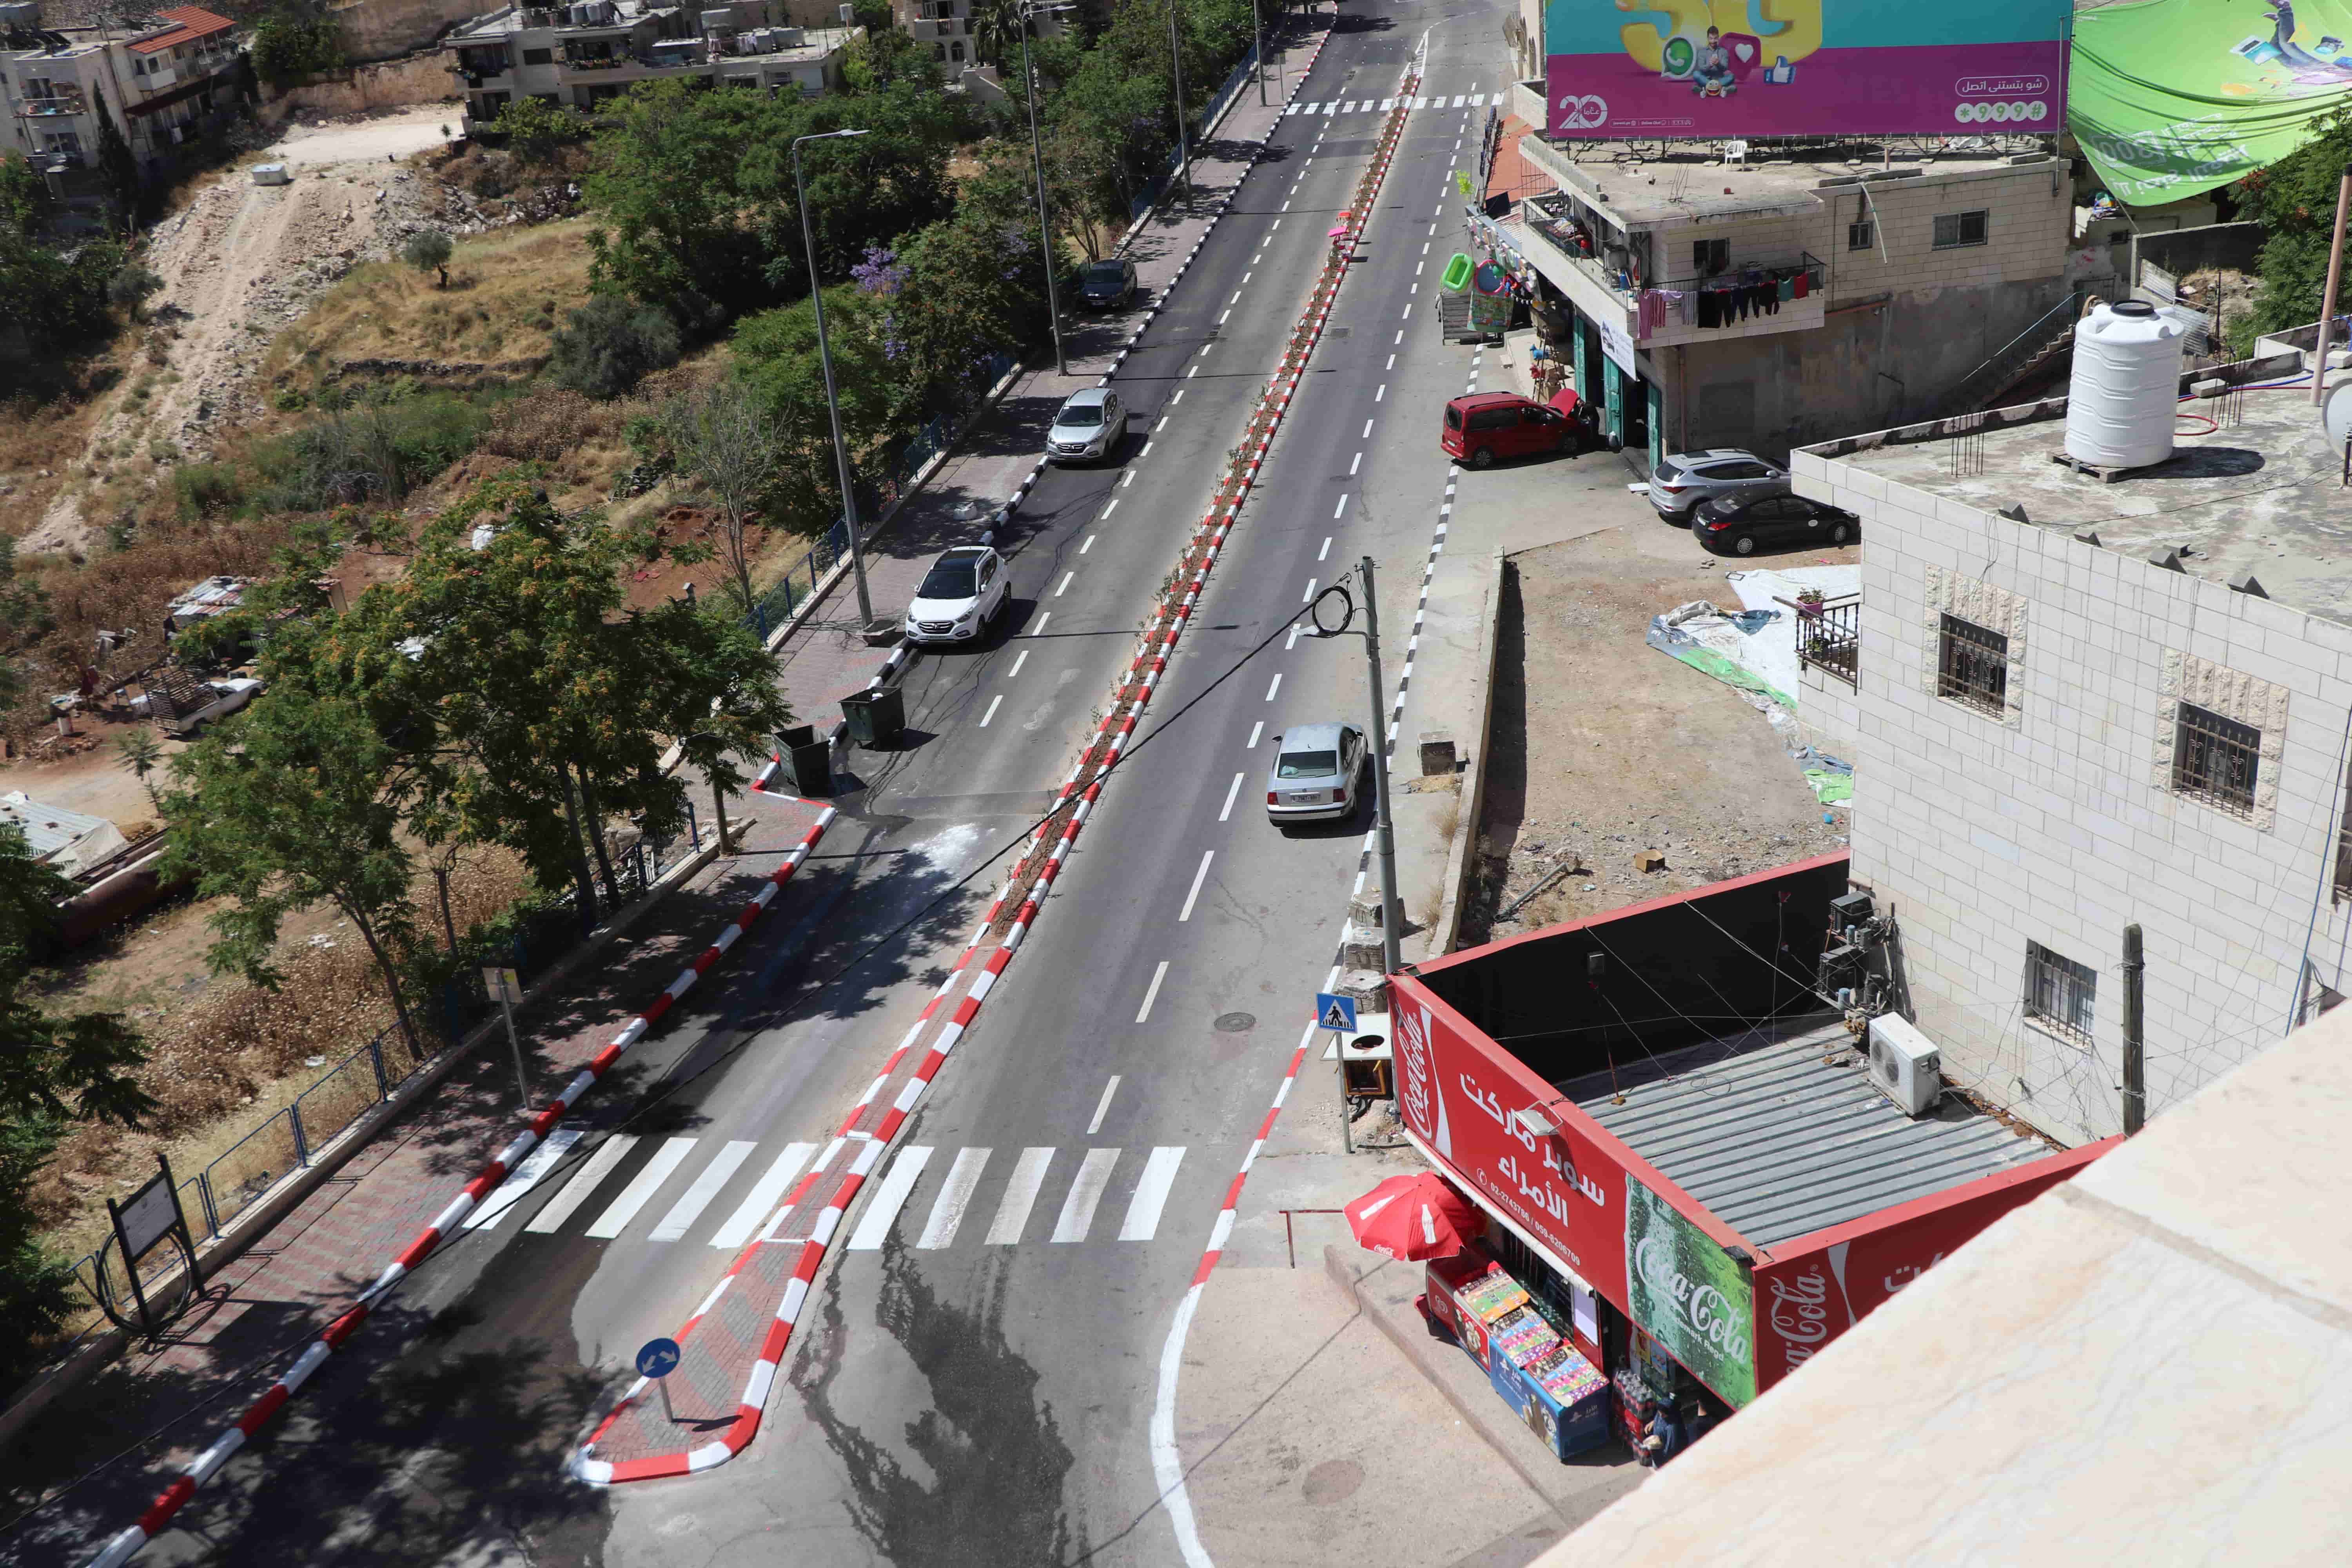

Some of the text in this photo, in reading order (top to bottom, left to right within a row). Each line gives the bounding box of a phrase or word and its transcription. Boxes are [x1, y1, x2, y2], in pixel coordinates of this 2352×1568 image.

[1558, 94, 1608, 129] 20
[1962, 78, 2042, 93] شو بتستنى اتصل
[1395, 1001, 1432, 1139] Coca-Cola
[1460, 1073, 1604, 1207] سوبر ماركت
[1498, 1156, 1568, 1227] الأمراء
[1635, 1237, 1747, 1365] Coca-Cola
